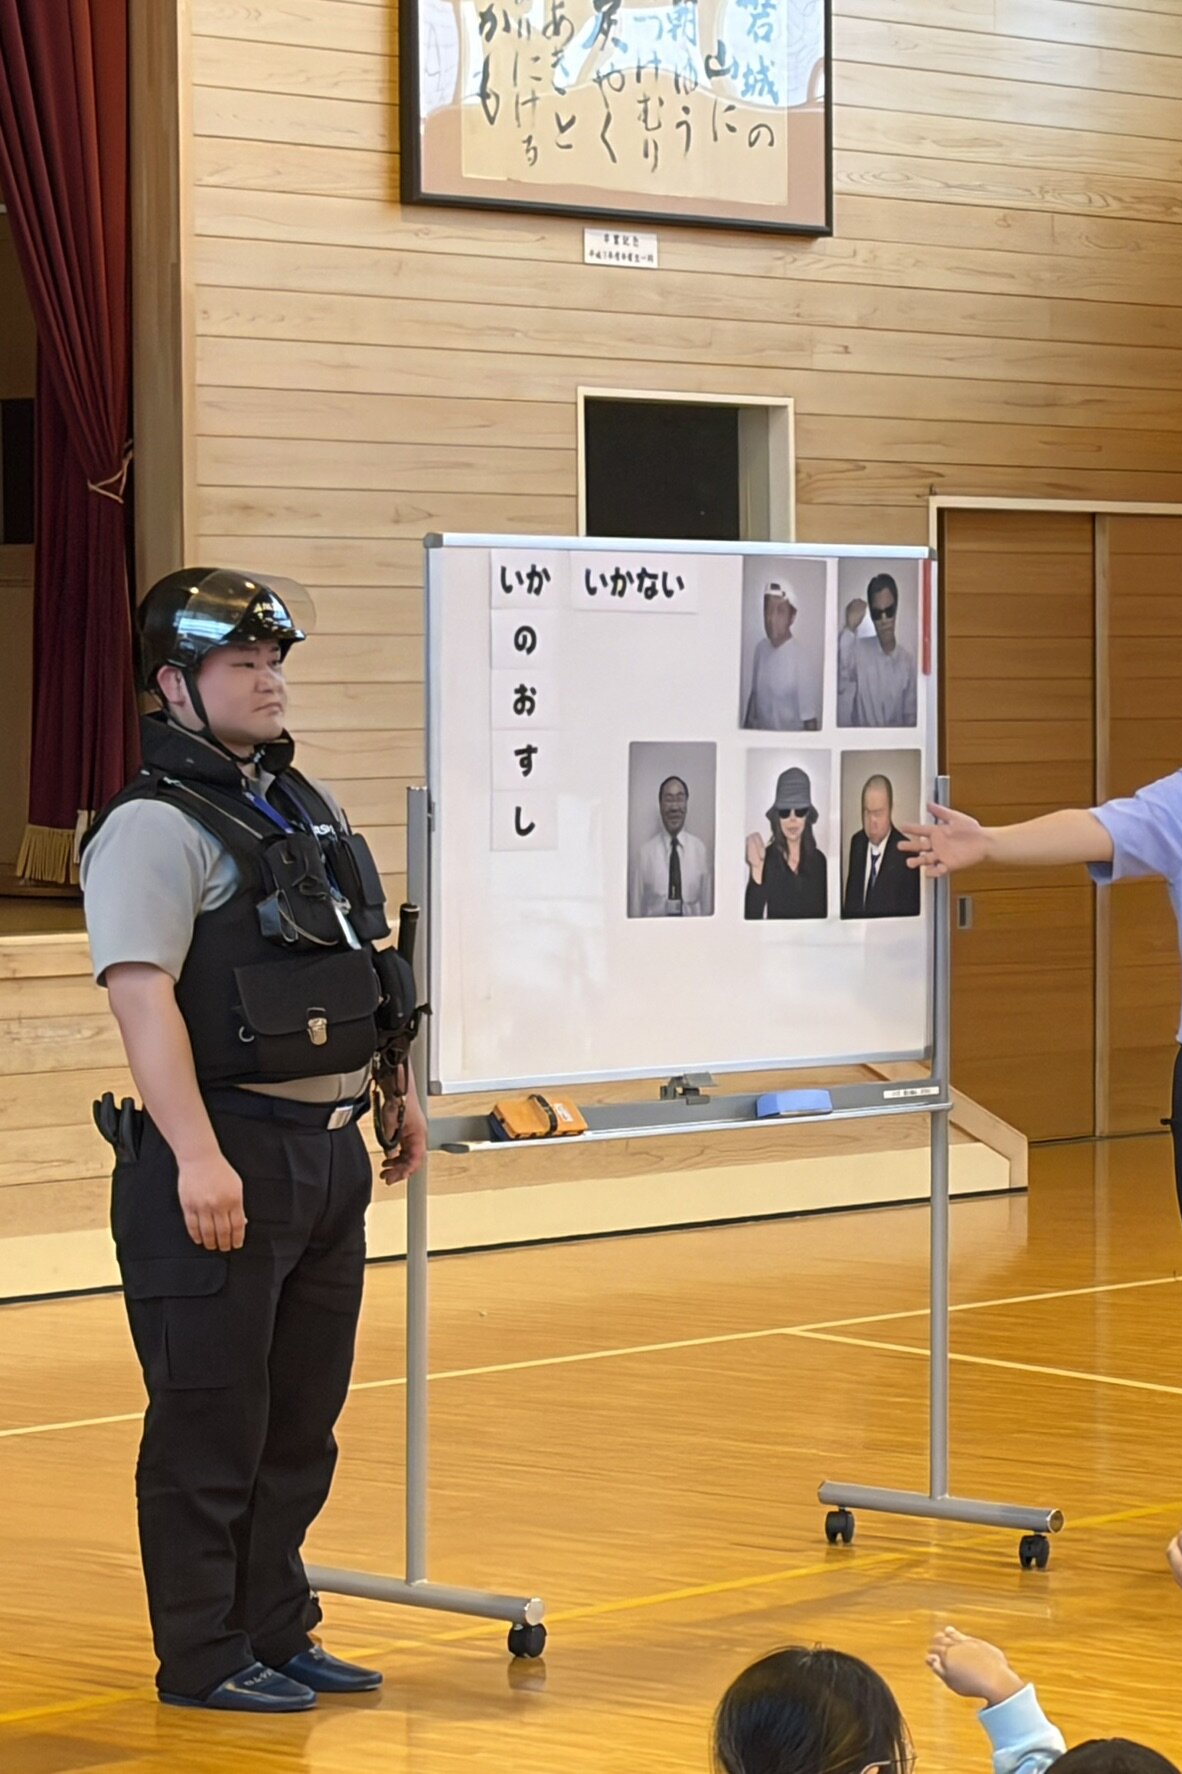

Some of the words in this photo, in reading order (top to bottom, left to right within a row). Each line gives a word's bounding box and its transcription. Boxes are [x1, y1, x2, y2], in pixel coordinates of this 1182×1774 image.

[500, 563, 551, 597] いか
[585, 566, 685, 600] いかない
[514, 625, 537, 655] の
[513, 683, 537, 716] お
[514, 744, 538, 777] す
[514, 806, 536, 837] し
